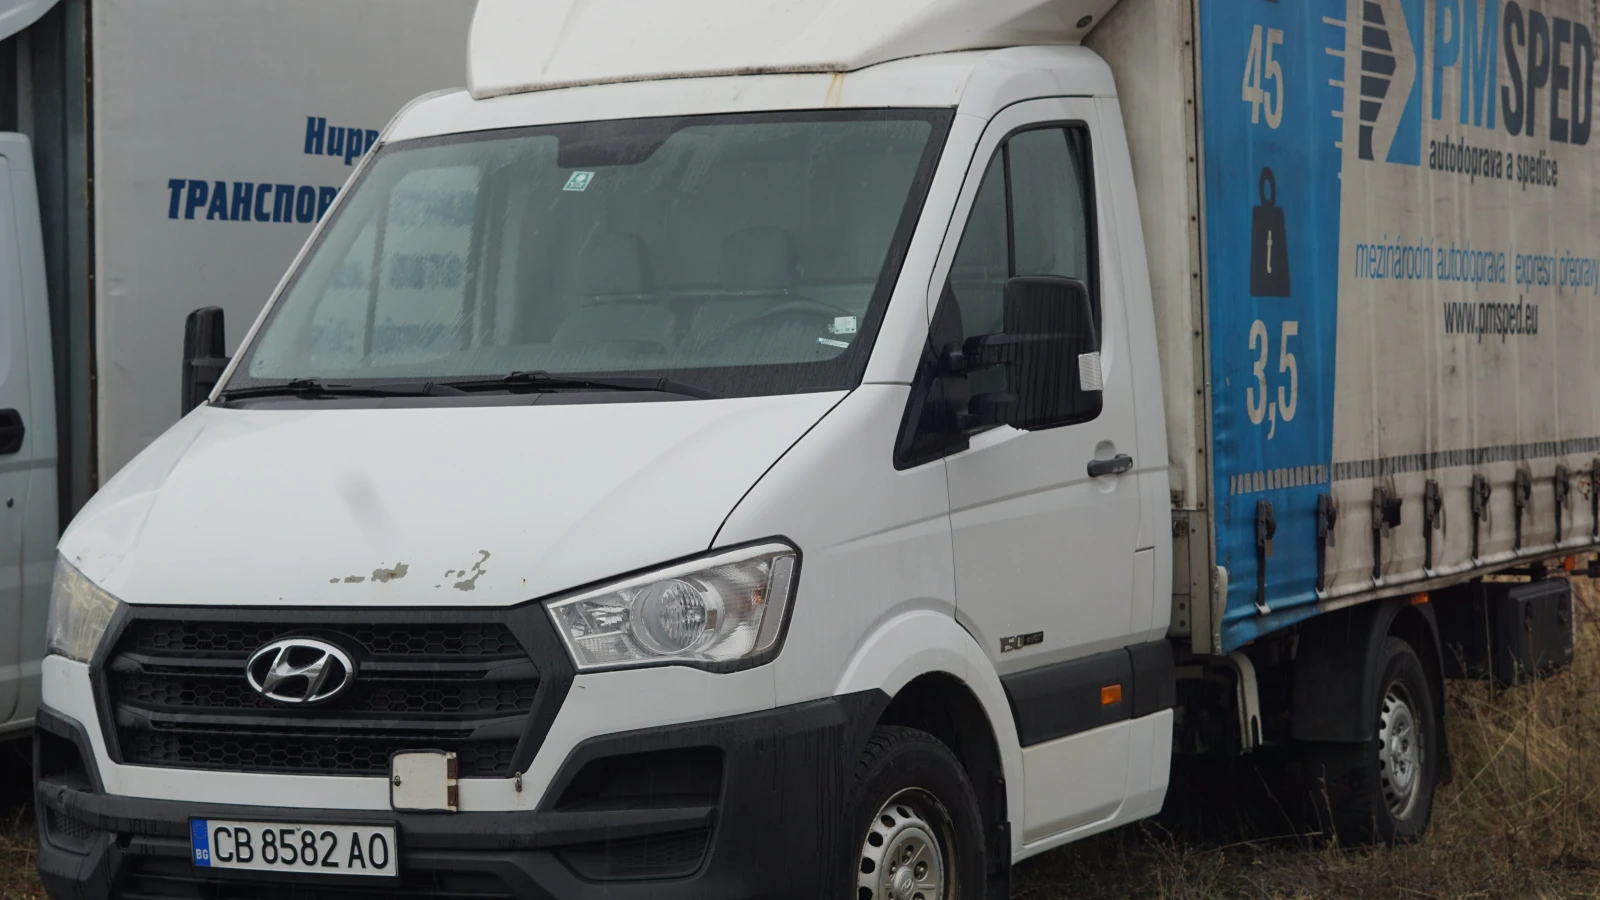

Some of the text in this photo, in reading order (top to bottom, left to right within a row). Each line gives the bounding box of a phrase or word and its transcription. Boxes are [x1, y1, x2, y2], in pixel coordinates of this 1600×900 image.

[1242, 24, 1284, 129] 45
[1429, 134, 1558, 191] autodoprava a spedice
[168, 178, 341, 224] ТРАНСПОР
[1266, 230, 1273, 274] t
[1355, 234, 1434, 279] mezinárodní
[1437, 240, 1505, 292] autodoprava
[1515, 247, 1558, 294] expresní
[1444, 294, 1538, 344] www.pmsped.eu
[1247, 319, 1298, 440] 3,5
[1000, 634, 1024, 653] 150
[195, 848, 209, 860] BG
[213, 826, 389, 870] CB 8582 AO
